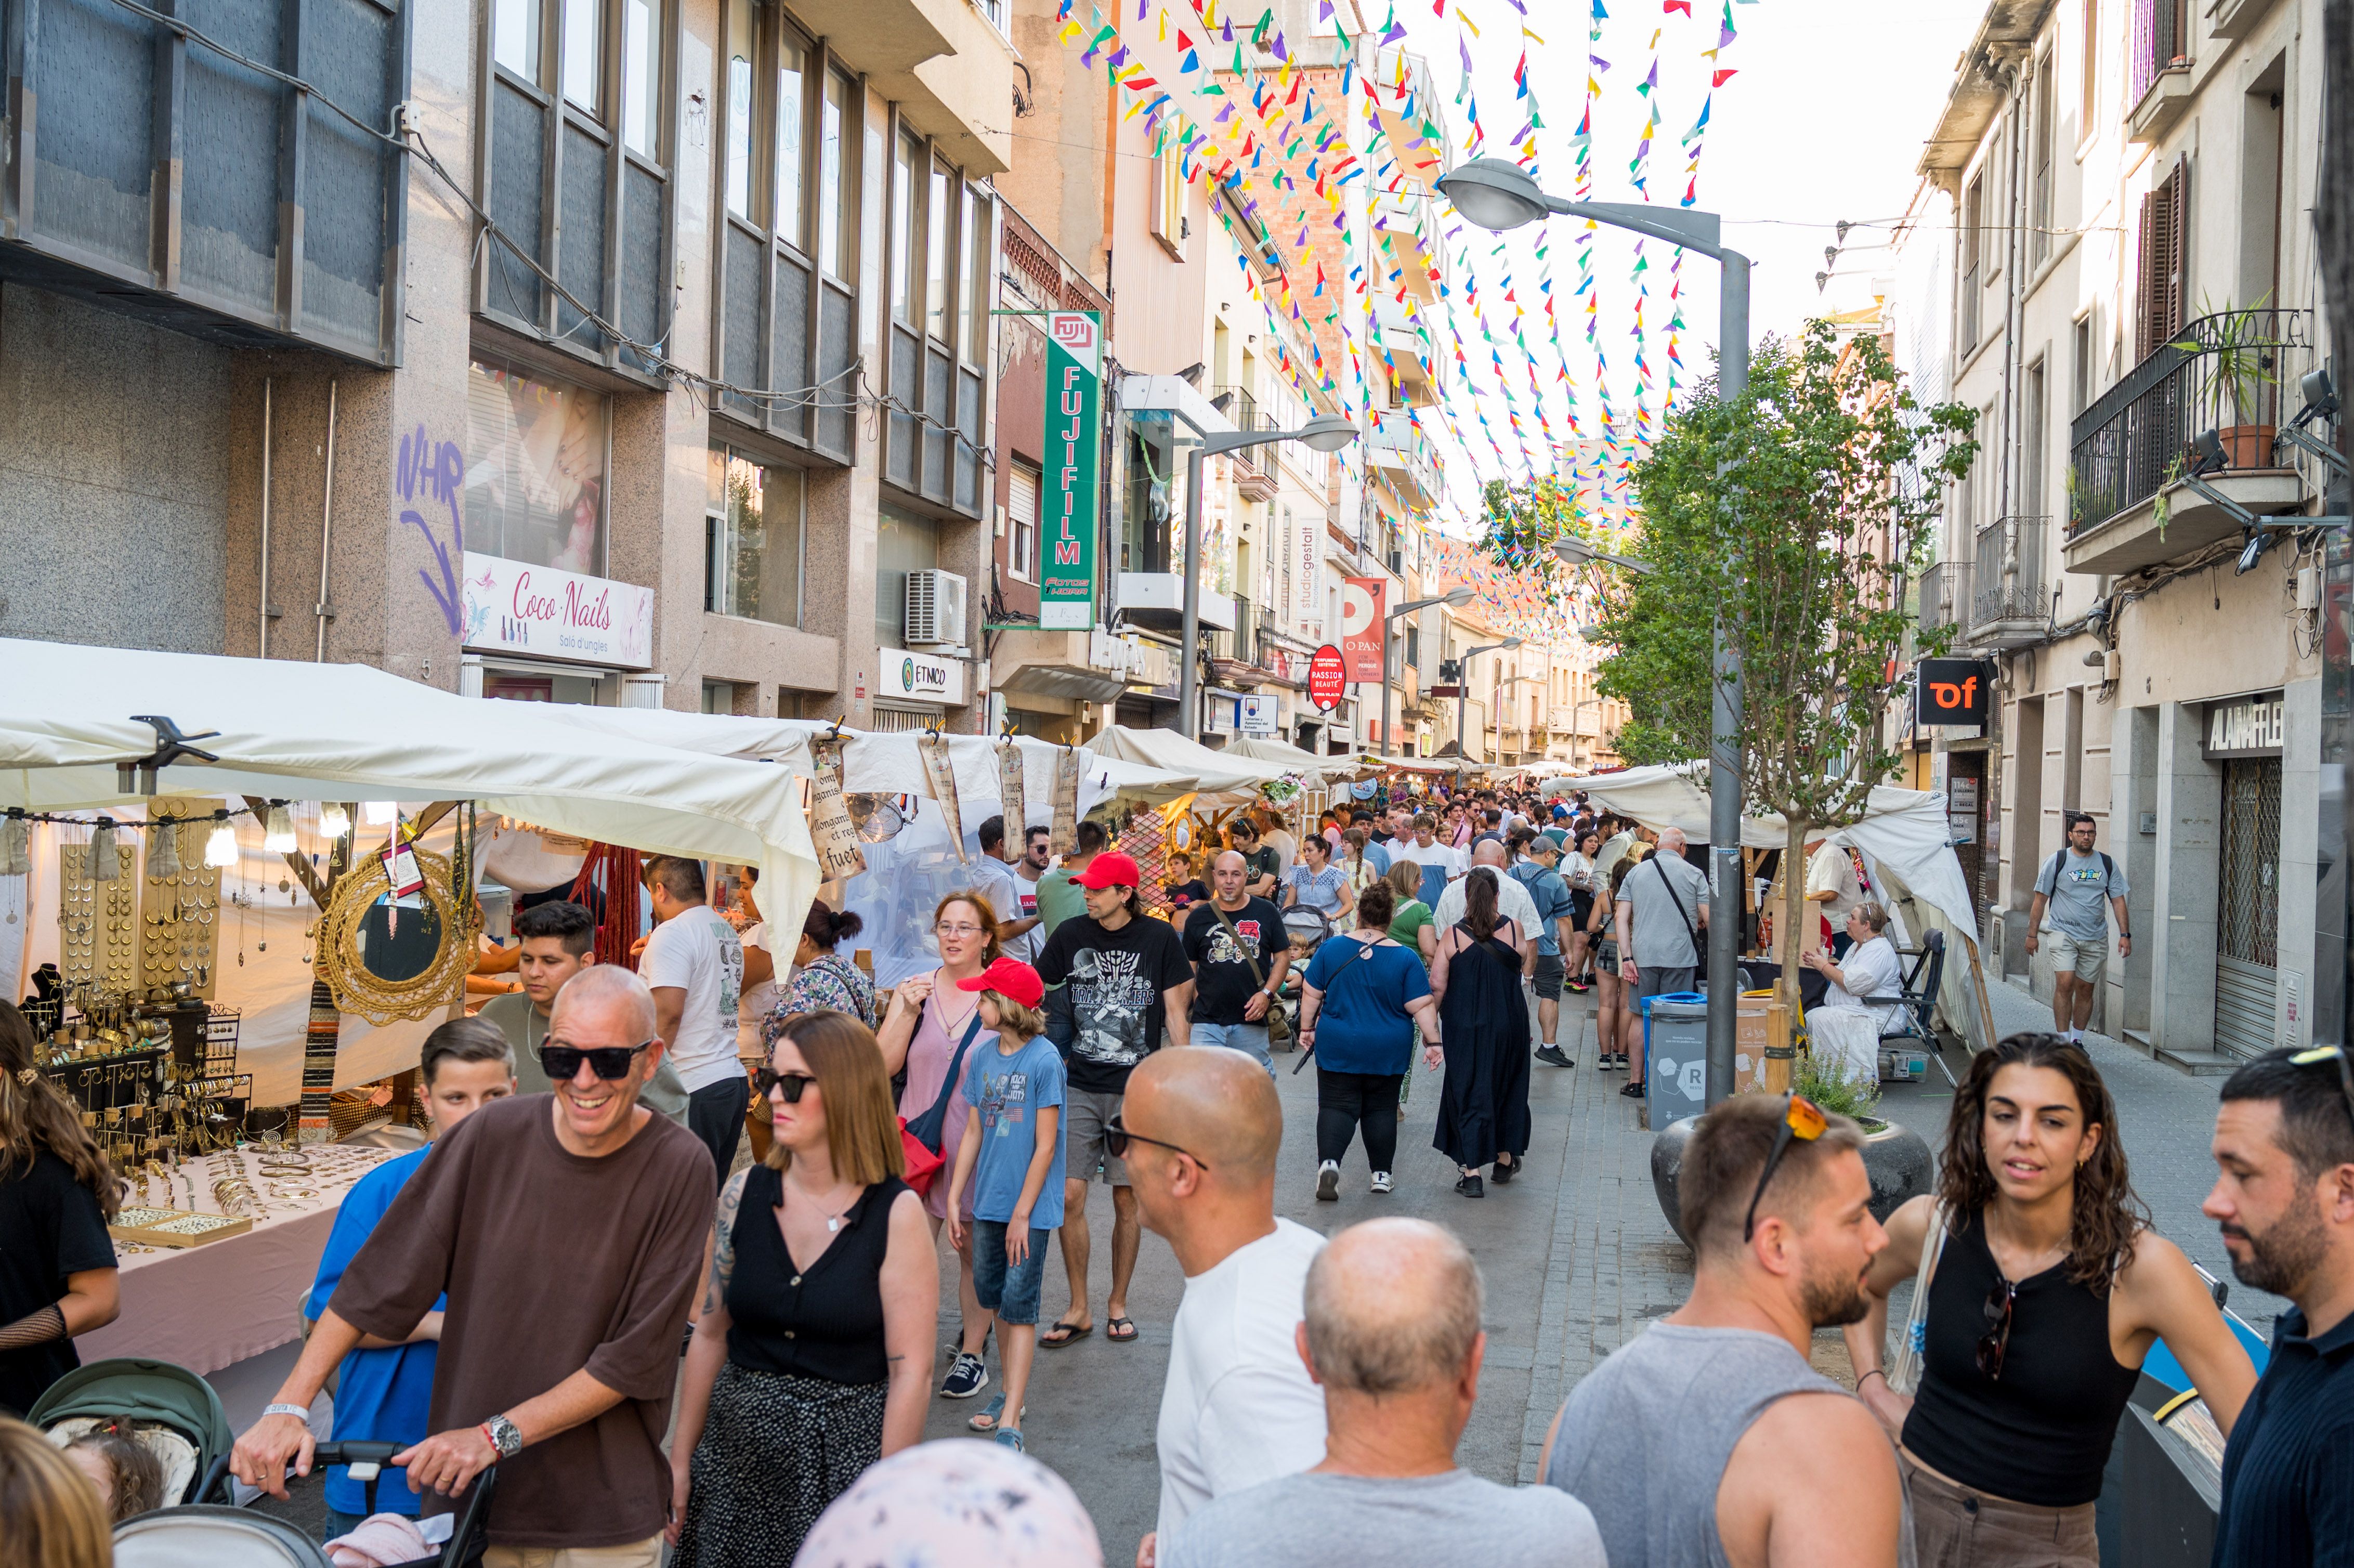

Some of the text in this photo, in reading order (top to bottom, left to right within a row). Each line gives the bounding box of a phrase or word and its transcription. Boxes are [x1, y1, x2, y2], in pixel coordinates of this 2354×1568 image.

[1055, 316, 1090, 343] FUJI
[1055, 367, 1082, 565] FUJIFILM
[1300, 527, 1314, 608] studiogestalt
[513, 571, 612, 630] Coco Nails
[1045, 586, 1051, 594] 1
[560, 634, 576, 649] Saló
[421, 658, 430, 680] 5
[832, 831, 840, 841] et
[827, 843, 859, 876] fuet
[1690, 1069, 1702, 1084] R
